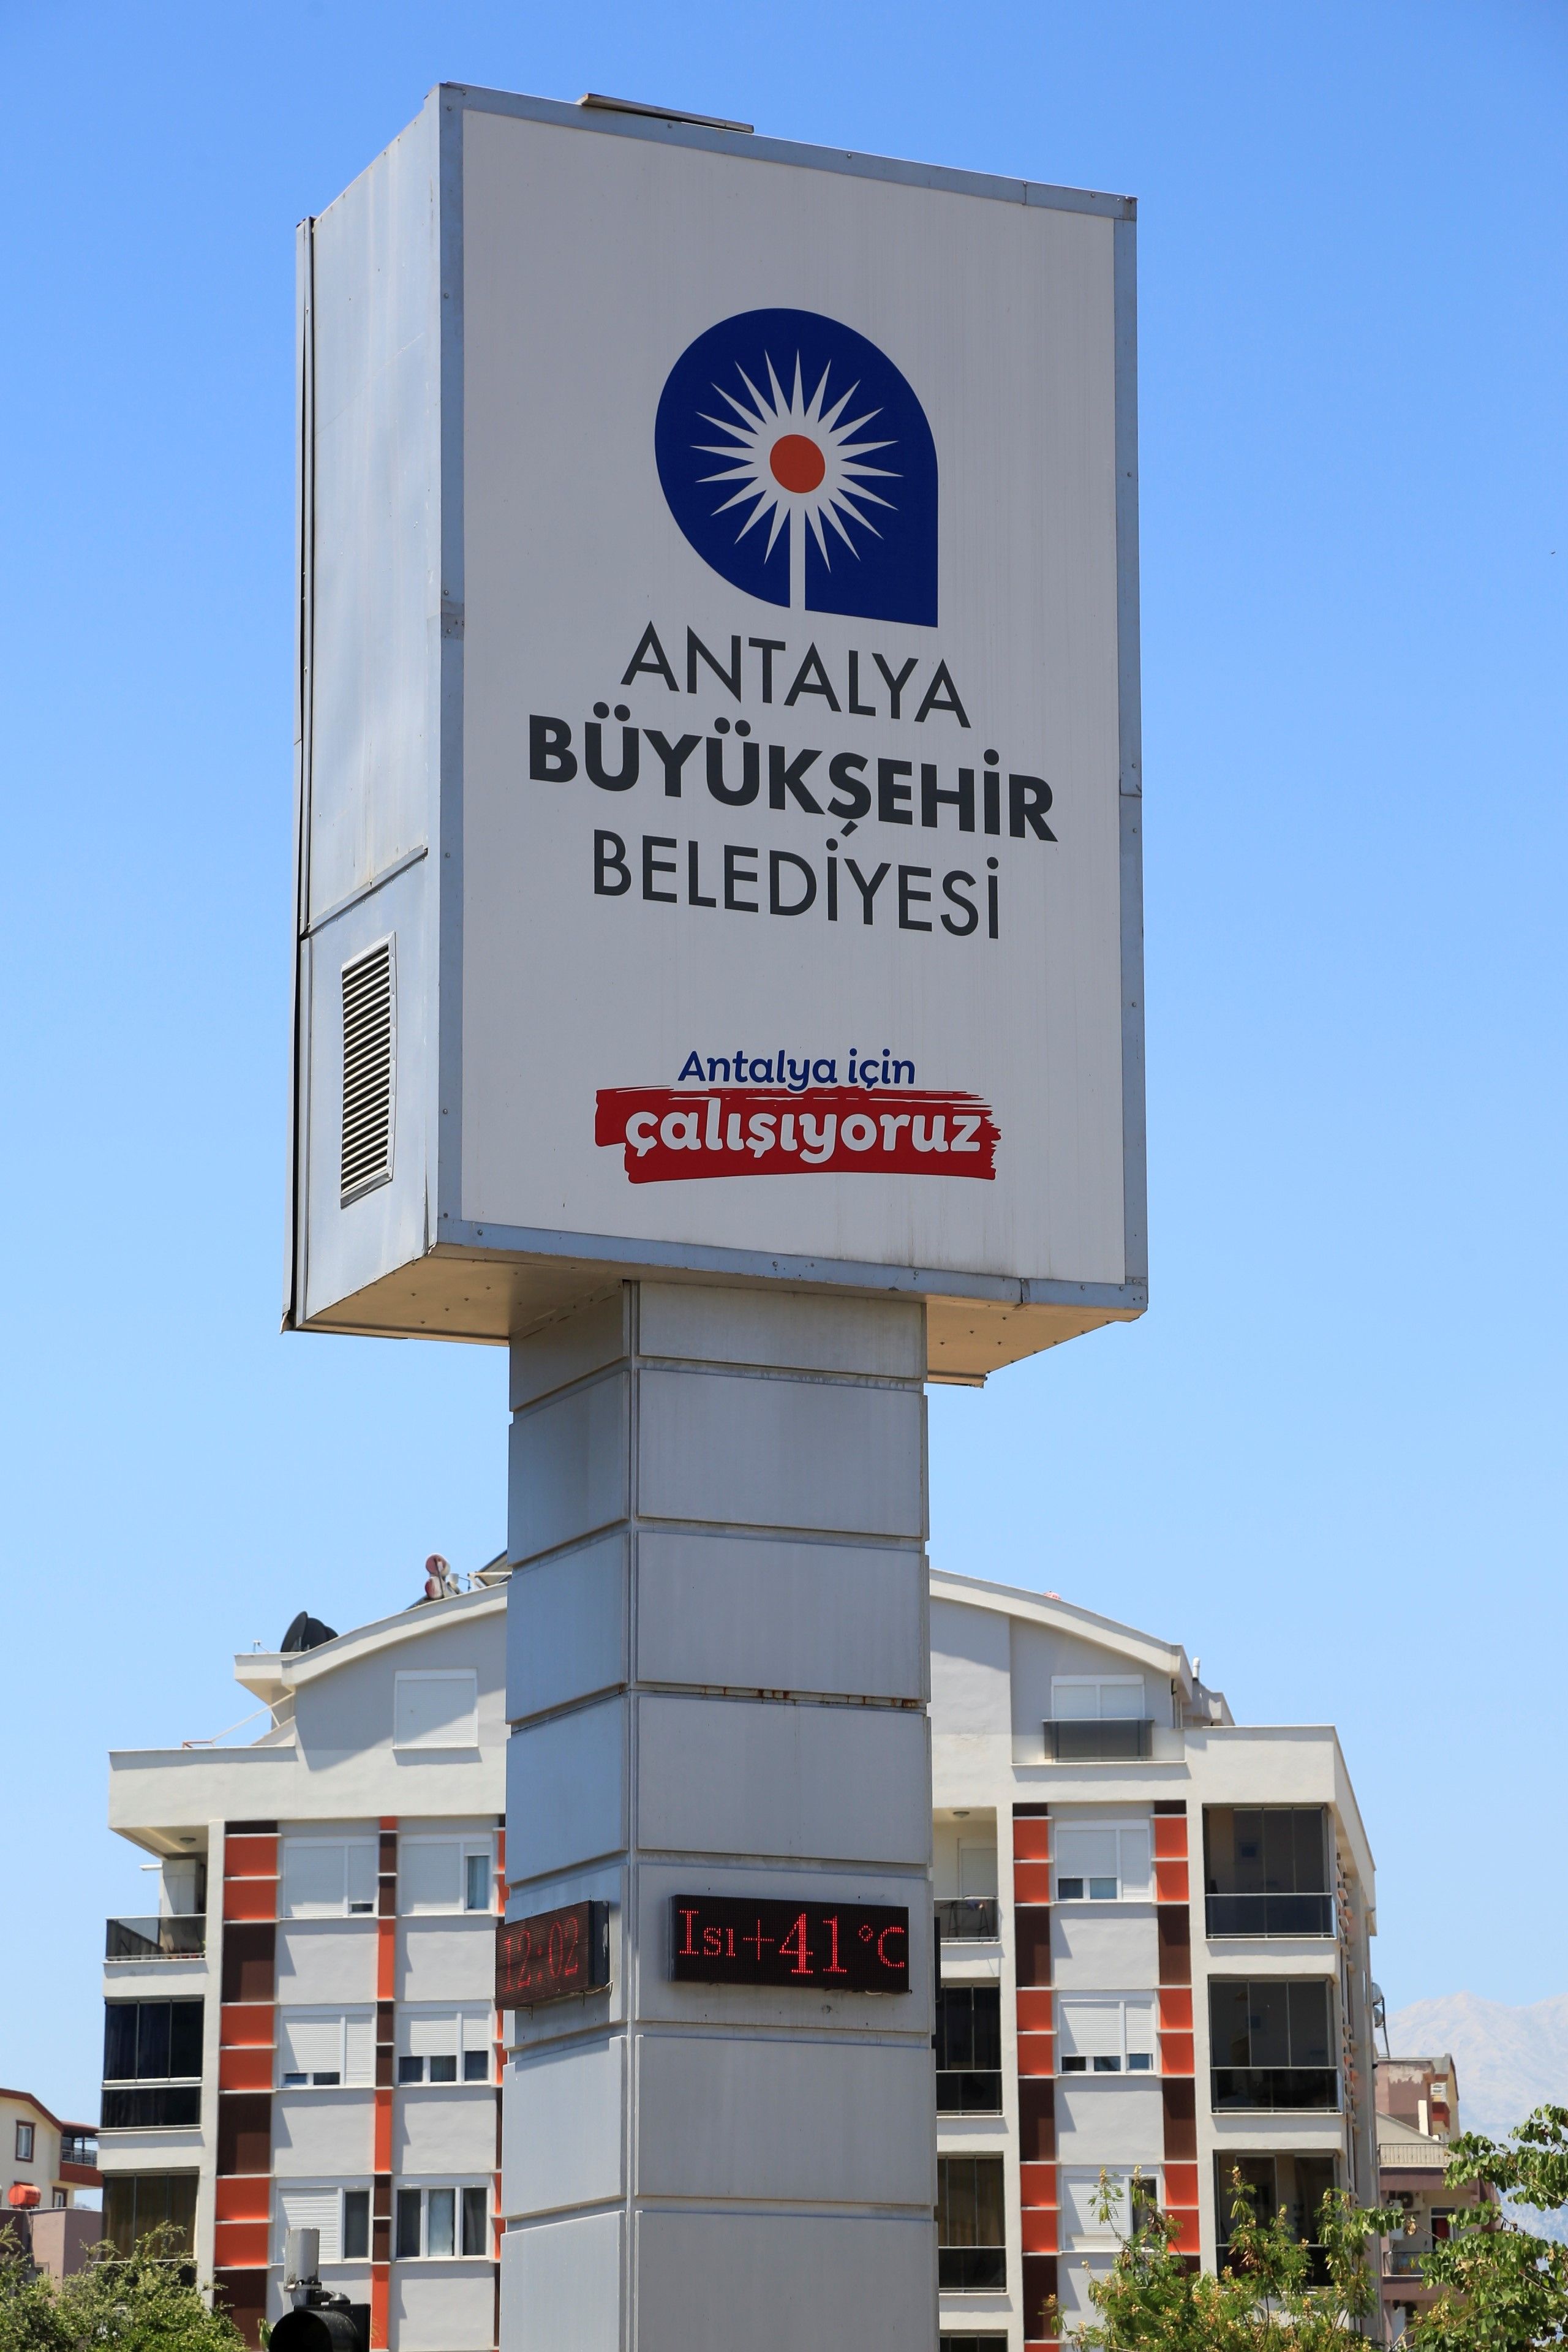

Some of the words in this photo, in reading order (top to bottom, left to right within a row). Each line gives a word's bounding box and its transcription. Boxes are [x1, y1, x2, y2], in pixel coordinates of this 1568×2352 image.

[620, 620, 972, 729] ANTALYA
[529, 701, 1059, 843] BÜYÜKŞEHİR
[594, 829, 1000, 940] BELEDİYESİ
[677, 1049, 838, 1092] Antalya
[848, 1048, 916, 1090] için
[625, 1098, 981, 1163] çalışıyoruz
[503, 1916, 579, 1993] 12:02
